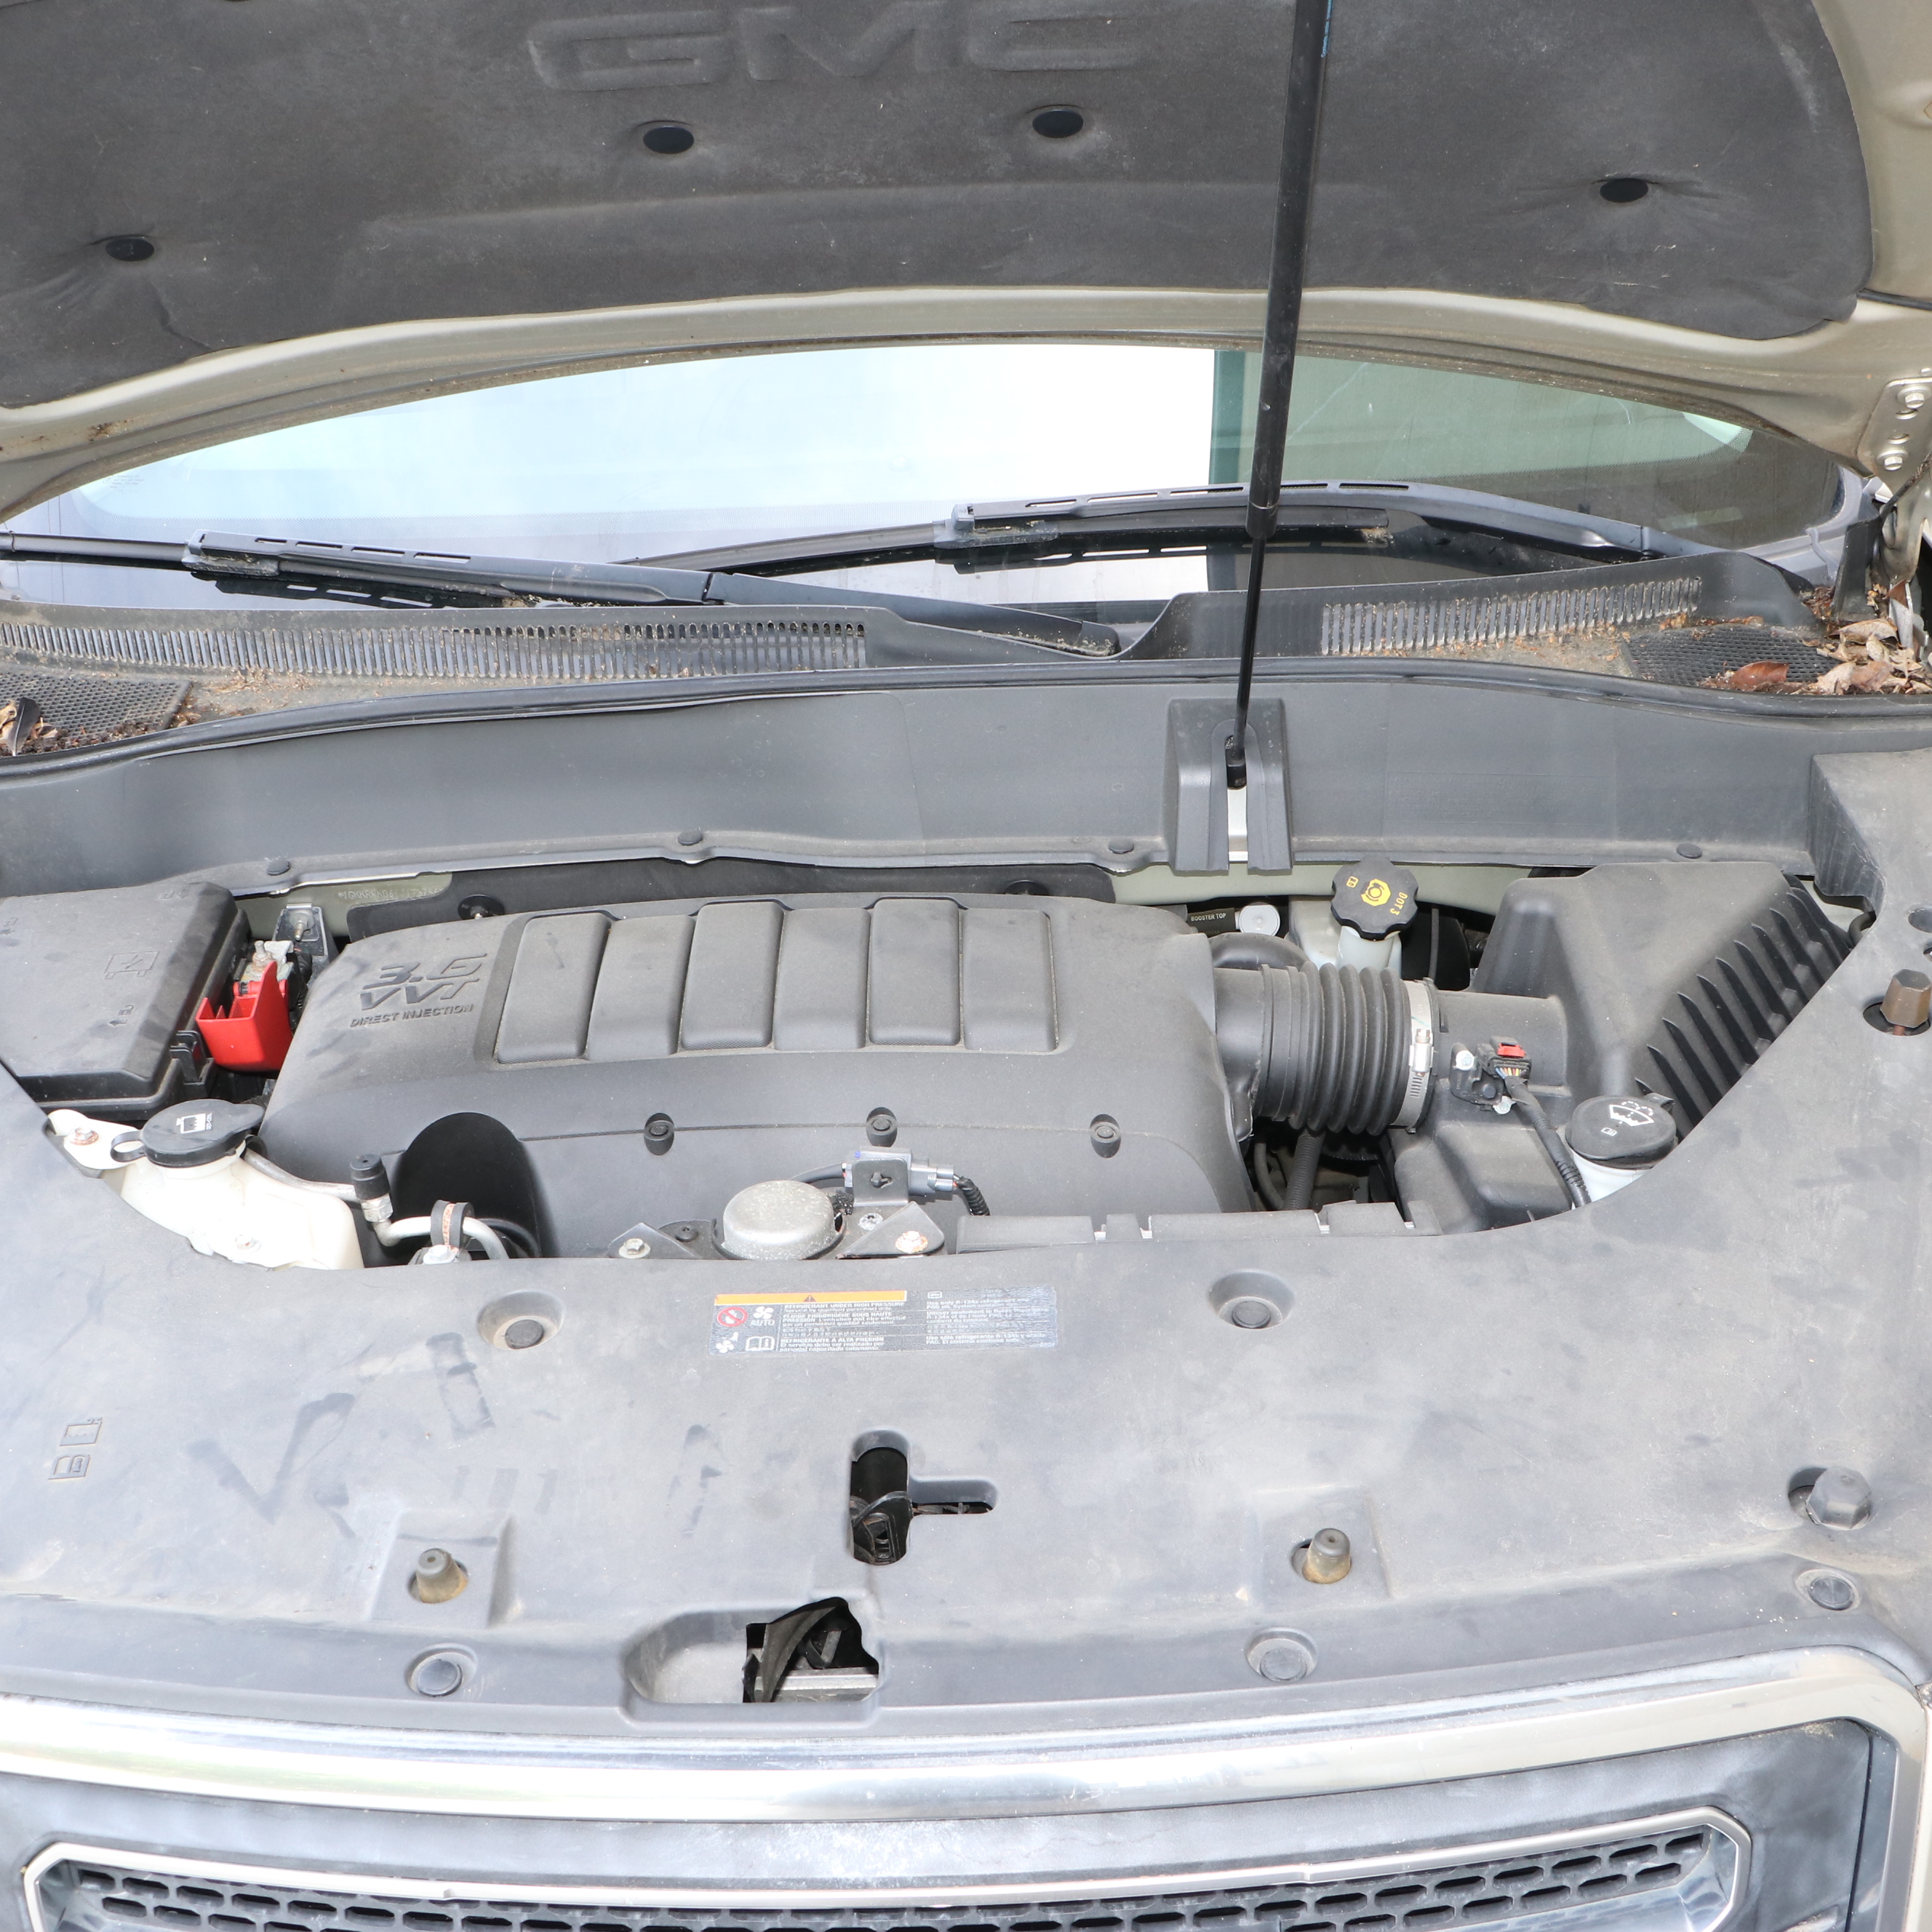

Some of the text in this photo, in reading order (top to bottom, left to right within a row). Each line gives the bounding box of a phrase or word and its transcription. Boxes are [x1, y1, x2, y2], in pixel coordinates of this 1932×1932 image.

[528, 0, 1139, 92] GMC
[1191, 914, 1216, 922] BOOSTER
[1389, 892, 1408, 916] DOT 3
[363, 953, 487, 990] 3.6
[360, 978, 480, 1010] VVT
[350, 1004, 474, 1028] DIRECT INJECTION
